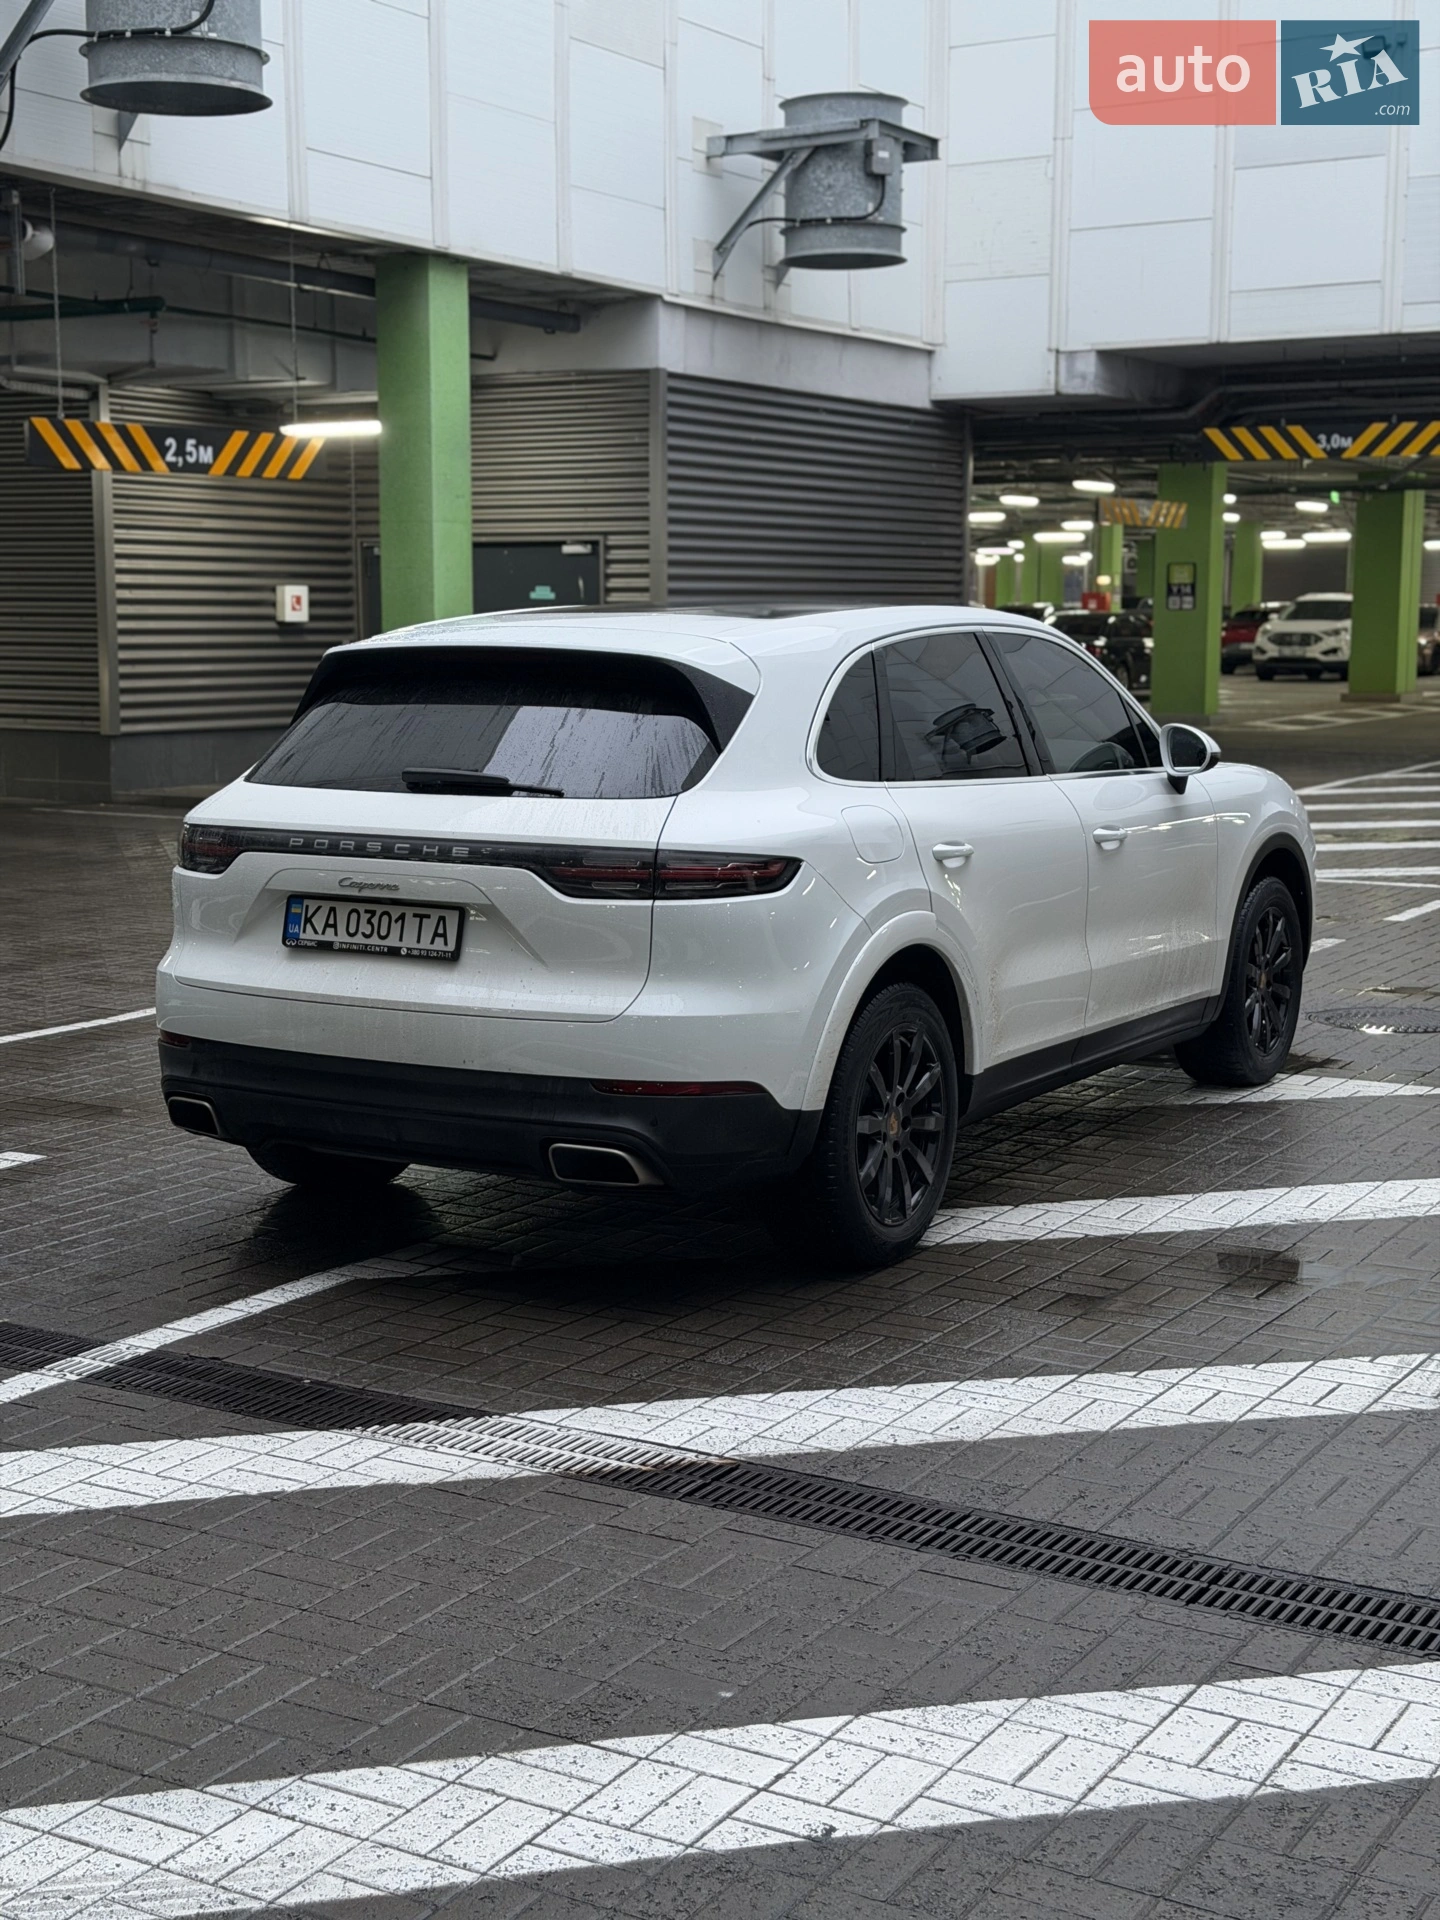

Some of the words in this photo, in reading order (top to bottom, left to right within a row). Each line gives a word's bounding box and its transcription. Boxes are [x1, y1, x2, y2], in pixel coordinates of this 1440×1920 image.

[289, 837, 470, 857] PORSCHE
[338, 876, 400, 893] Cayenne
[288, 924, 300, 934] UA
